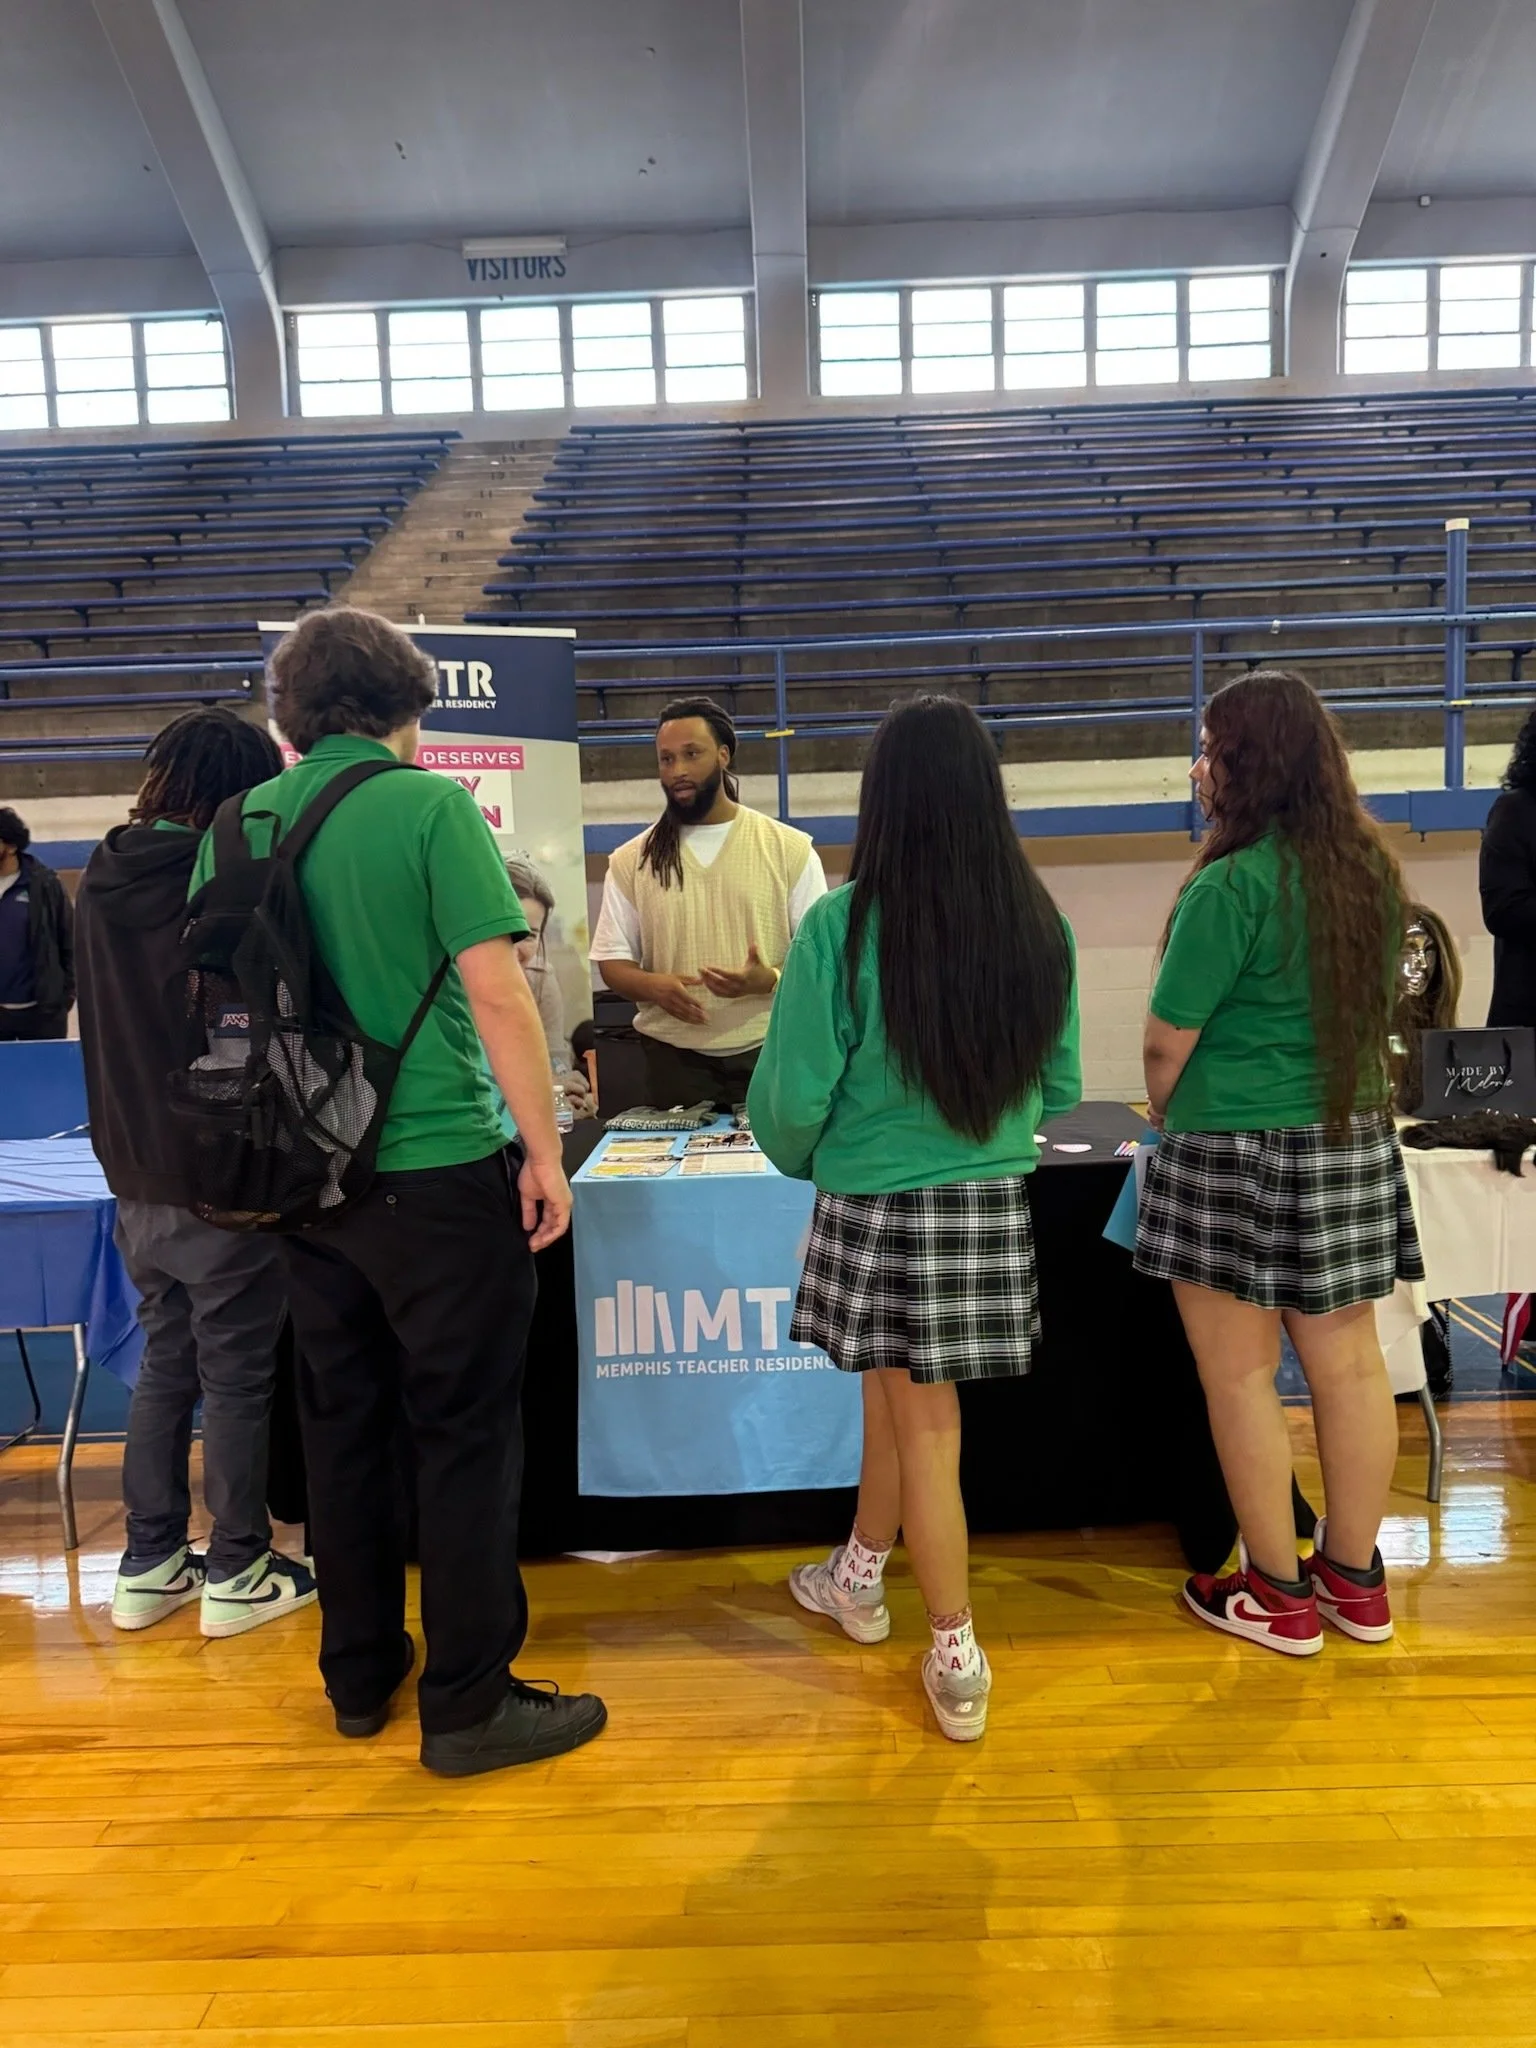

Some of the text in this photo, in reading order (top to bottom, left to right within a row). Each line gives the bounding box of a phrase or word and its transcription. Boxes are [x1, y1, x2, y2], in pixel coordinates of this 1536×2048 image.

[466, 255, 566, 281] VISITORS
[445, 700, 497, 709] RESIDENCY
[422, 751, 521, 765] DESERVES
[683, 1287, 816, 1353] MT
[596, 1360, 672, 1379] MEMPHIS
[676, 1358, 749, 1375] TEACHER
